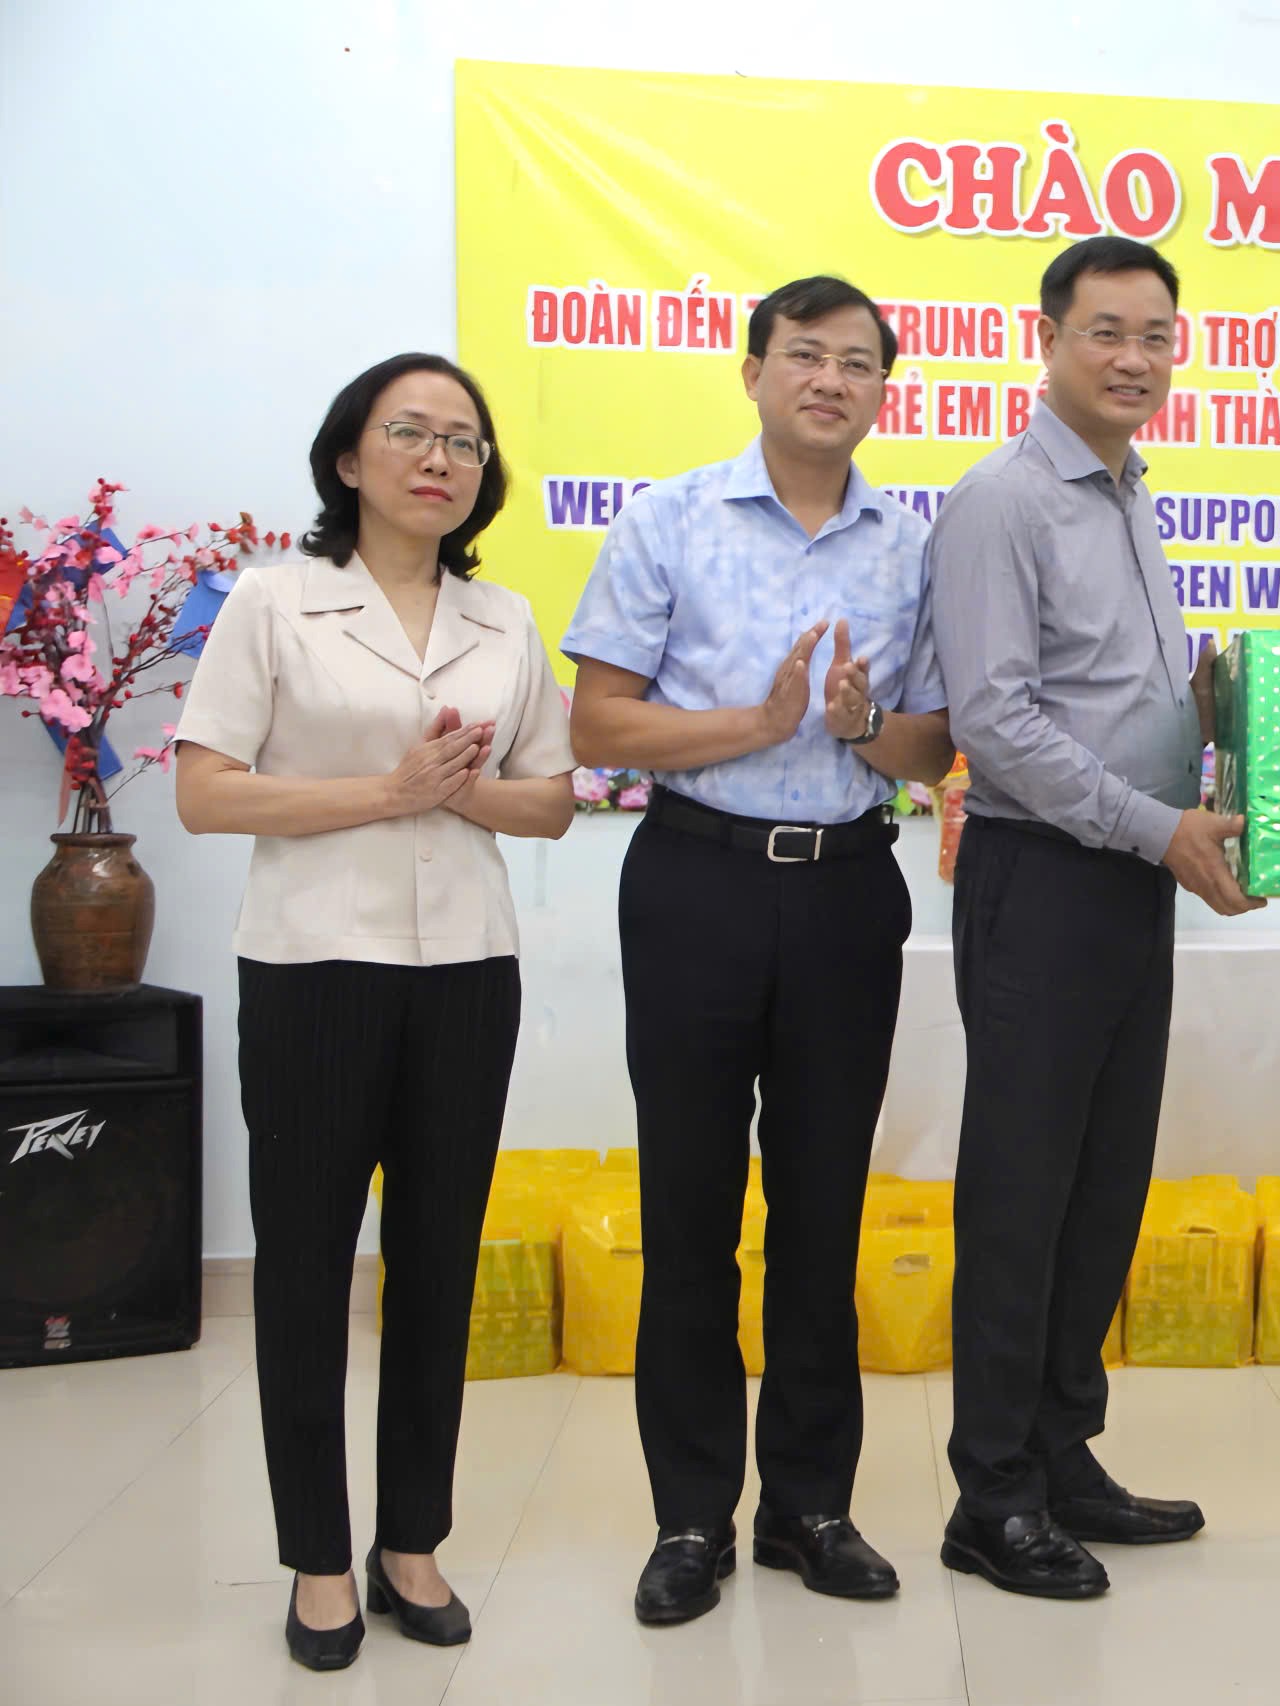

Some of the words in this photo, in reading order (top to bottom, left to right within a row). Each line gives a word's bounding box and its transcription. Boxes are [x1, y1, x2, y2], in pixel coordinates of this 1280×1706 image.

[873, 122, 1180, 240] CHÀO
[531, 283, 642, 346] ĐOÀN
[656, 279, 732, 349] ĐẾN
[1204, 311, 1278, 379] TRỢ
[938, 385, 991, 437] EM
